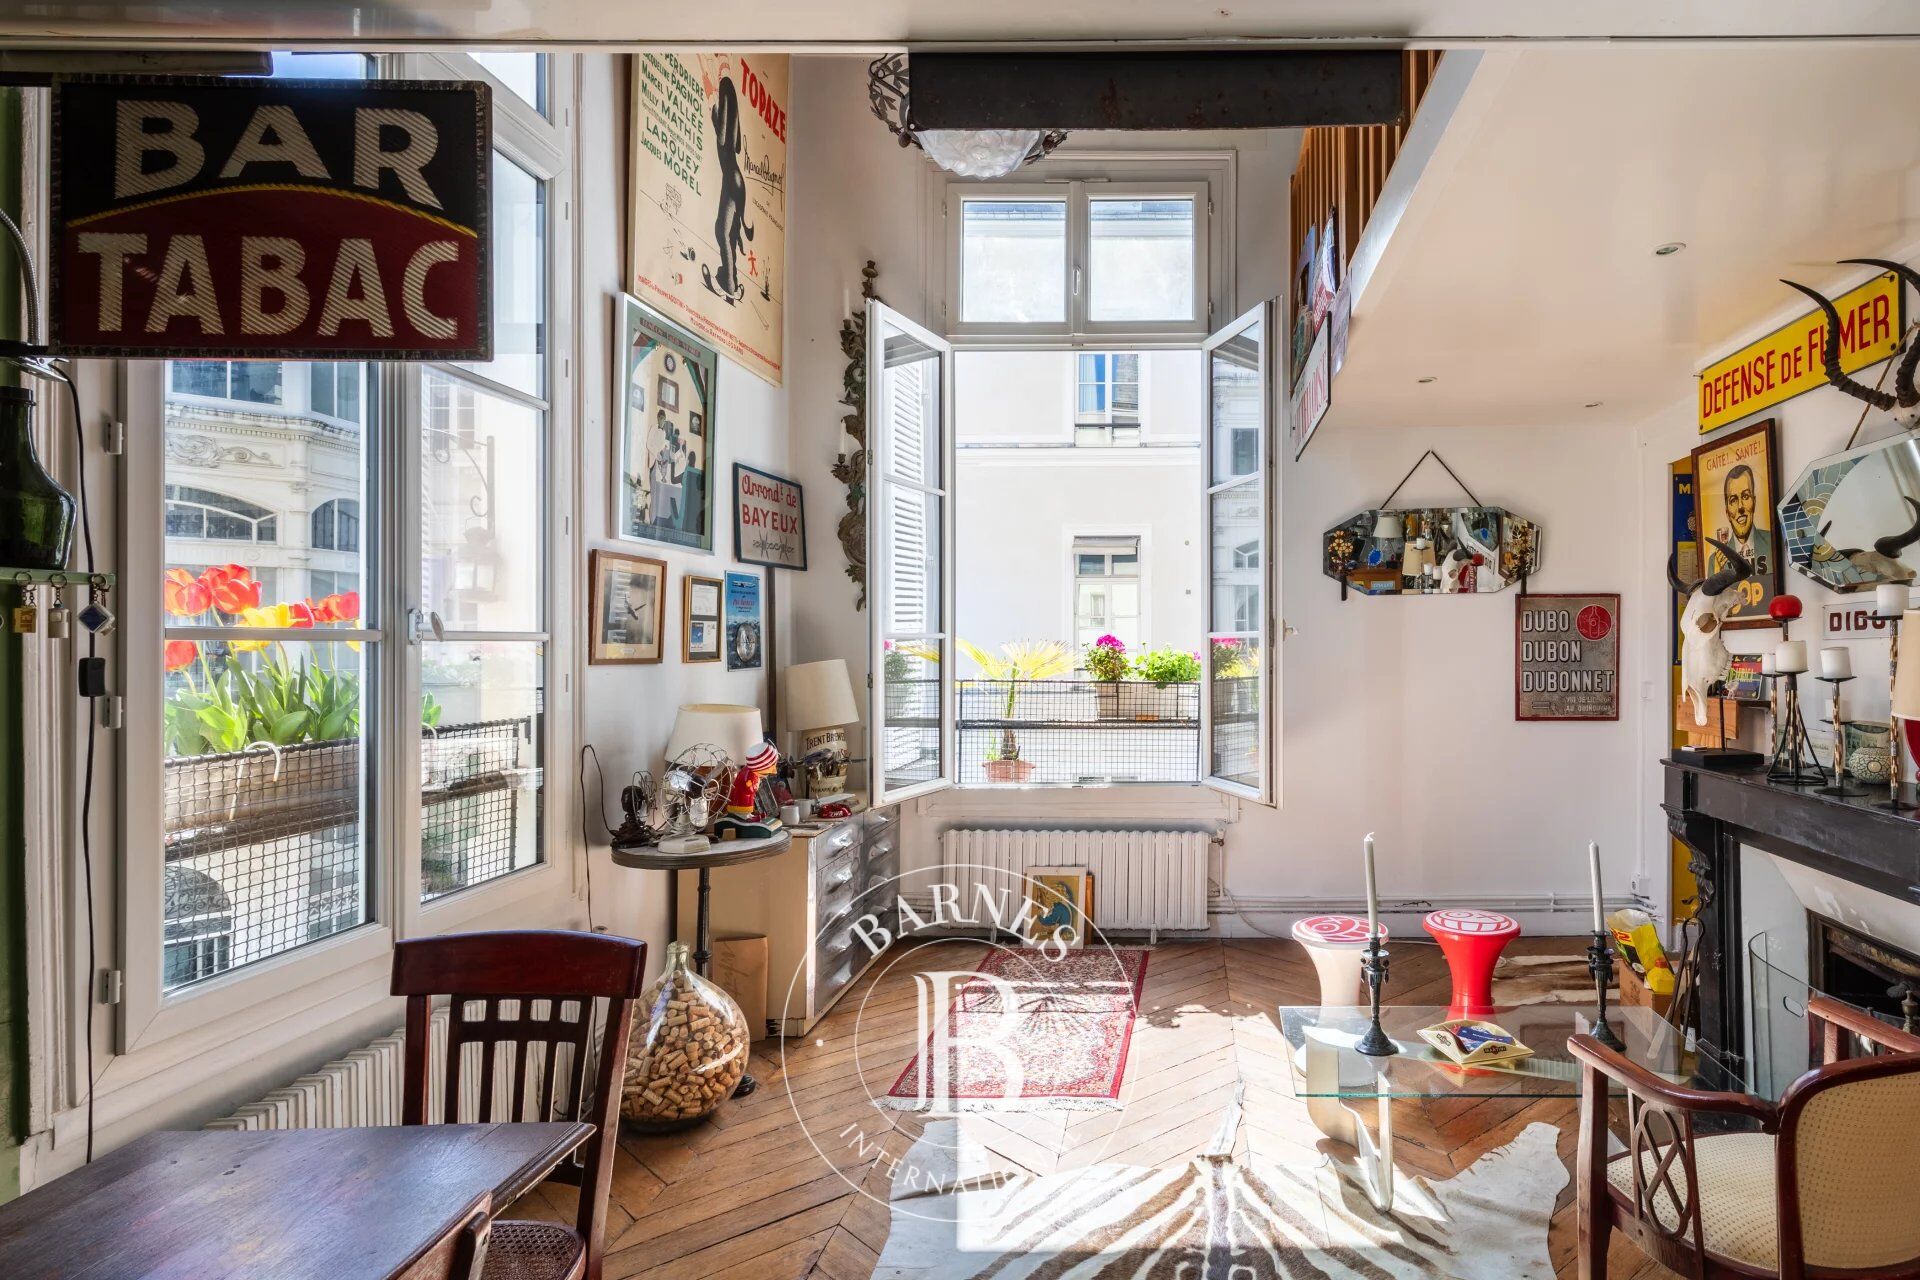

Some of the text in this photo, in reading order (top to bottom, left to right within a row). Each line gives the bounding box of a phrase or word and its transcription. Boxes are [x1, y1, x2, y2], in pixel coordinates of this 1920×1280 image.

[671, 72, 704, 118] PAGNOL
[741, 57, 786, 145] TOPAZE
[646, 116, 699, 175] LARQUEY
[661, 99, 703, 152] MATHIS
[113, 99, 444, 210] BAR
[664, 151, 702, 197] MOREL
[78, 231, 460, 340] TABAC
[1703, 349, 1776, 419] DEFENSE
[1780, 345, 1803, 385] DE
[742, 503, 798, 535] BAYEUX
[1522, 610, 1570, 632] DUBO
[1522, 640, 1582, 663] DUBON
[1522, 670, 1615, 693] DUBONNET
